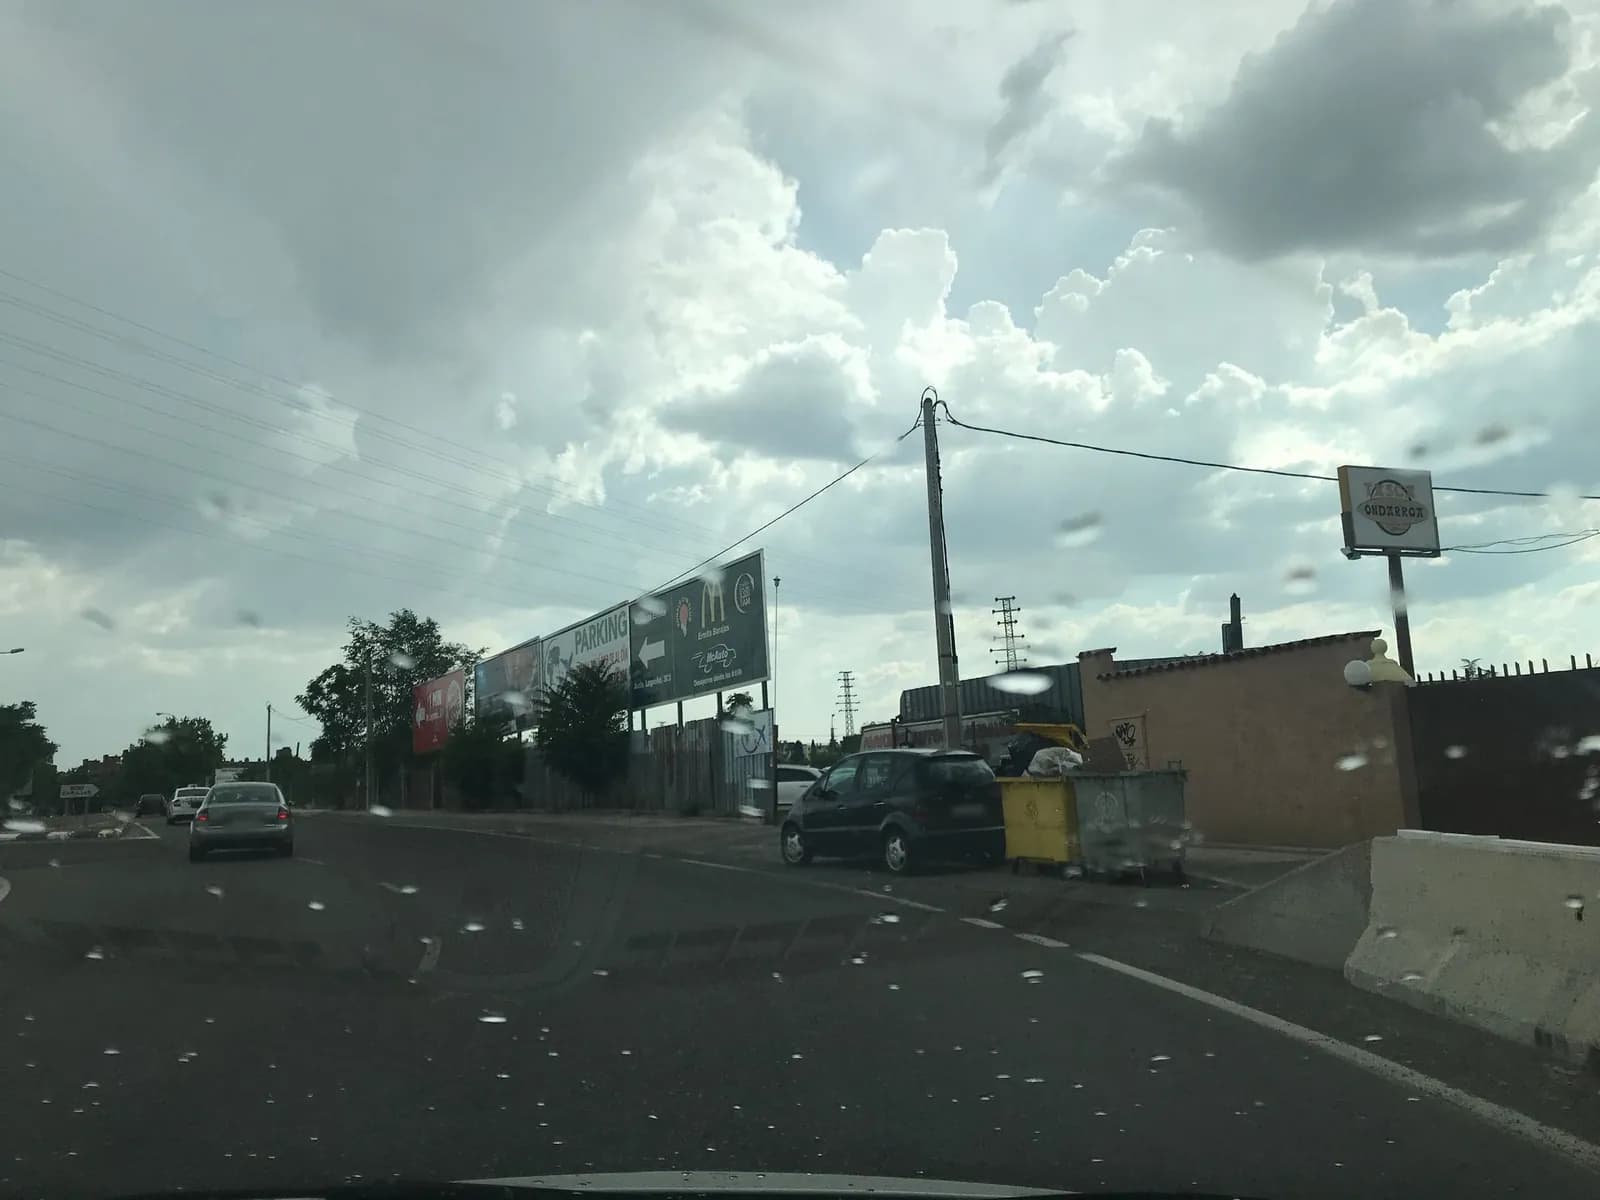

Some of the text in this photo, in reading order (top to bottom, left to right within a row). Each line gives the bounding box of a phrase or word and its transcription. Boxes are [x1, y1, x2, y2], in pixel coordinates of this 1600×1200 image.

[1364, 504, 1424, 518] ONDARROA
[575, 610, 627, 655] PARKING
[707, 649, 729, 663] McAuto
